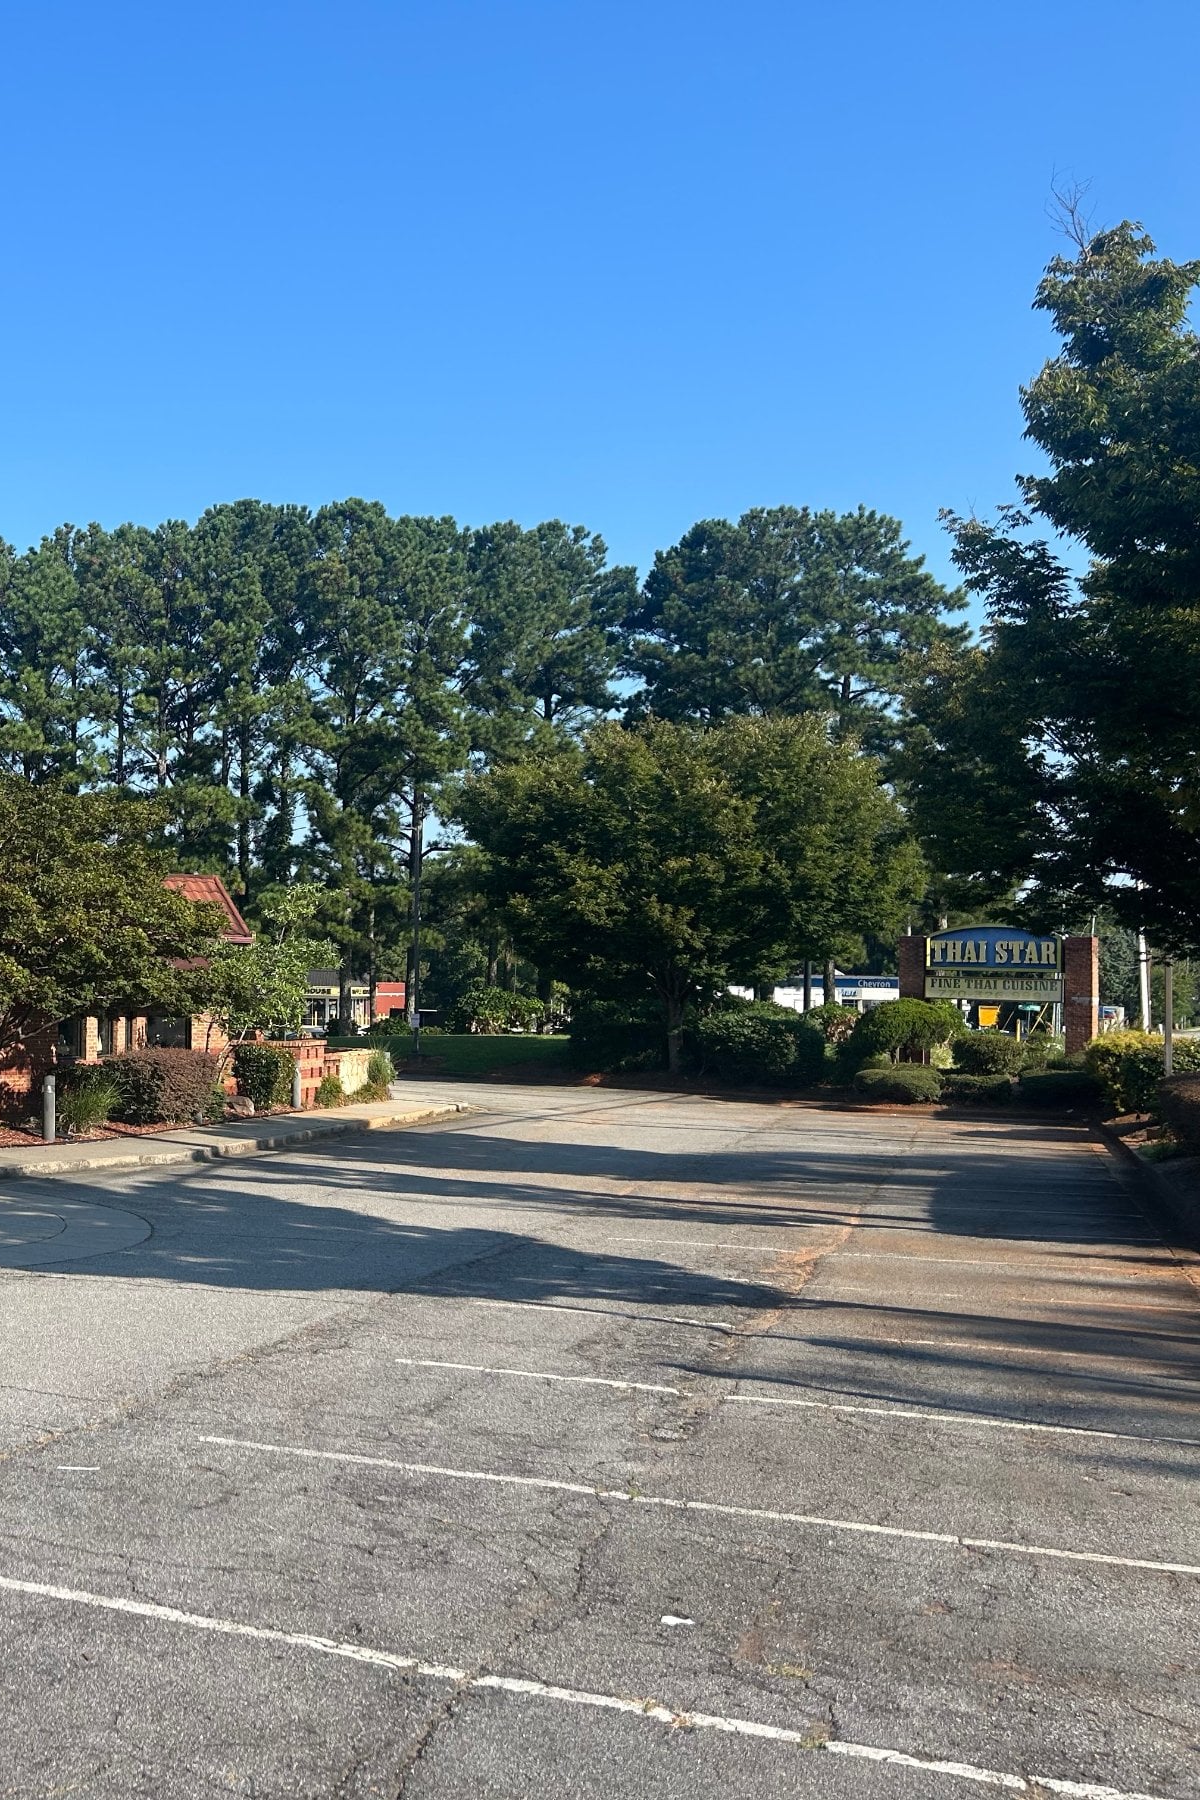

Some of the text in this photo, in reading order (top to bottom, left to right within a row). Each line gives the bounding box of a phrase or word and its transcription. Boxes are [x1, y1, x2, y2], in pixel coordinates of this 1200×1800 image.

[931, 940, 1057, 965] THAI STAR
[857, 979, 891, 988] Chevron
[931, 978, 1058, 992] FINE THAI CUISINE
